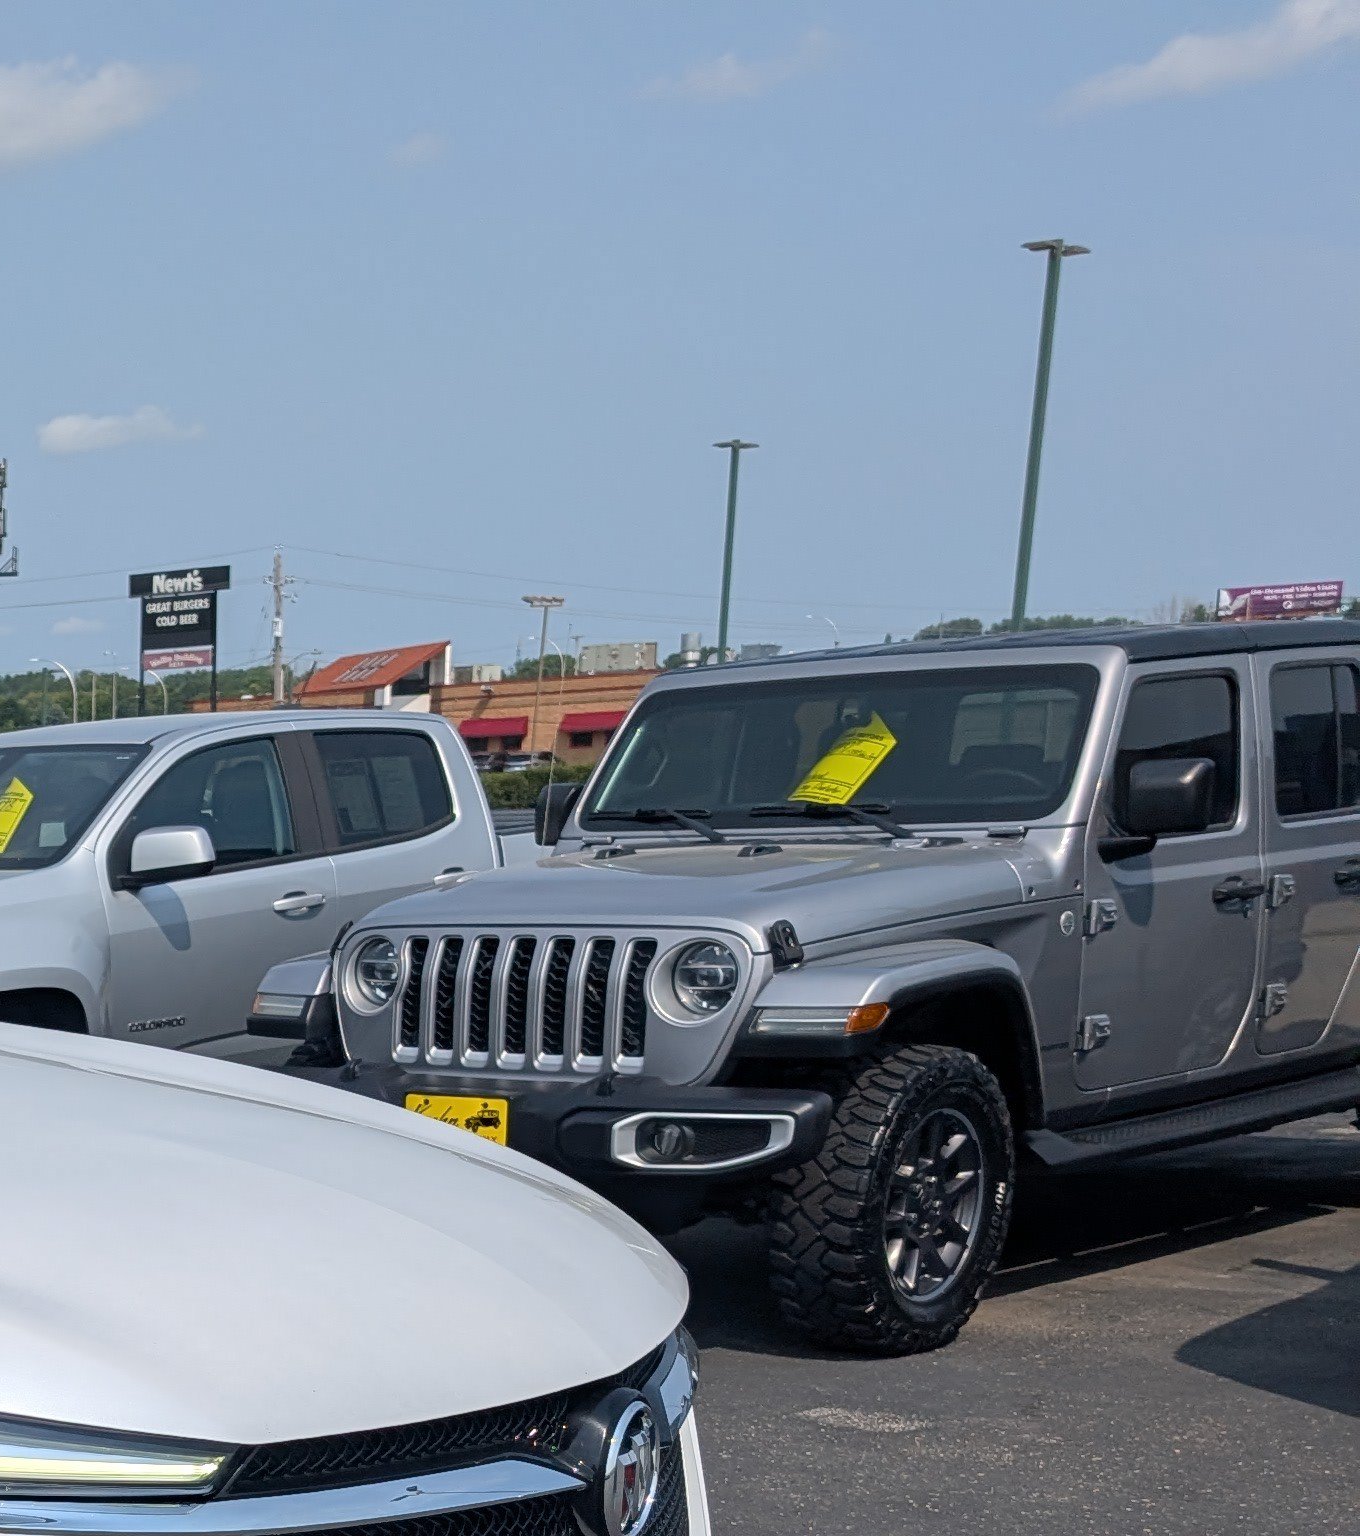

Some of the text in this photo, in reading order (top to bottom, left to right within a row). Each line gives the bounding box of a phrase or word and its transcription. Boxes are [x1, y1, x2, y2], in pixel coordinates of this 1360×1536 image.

[152, 570, 203, 594] Newt's
[146, 598, 210, 614] GREAT BURGERS
[156, 613, 199, 627] COLD BEER
